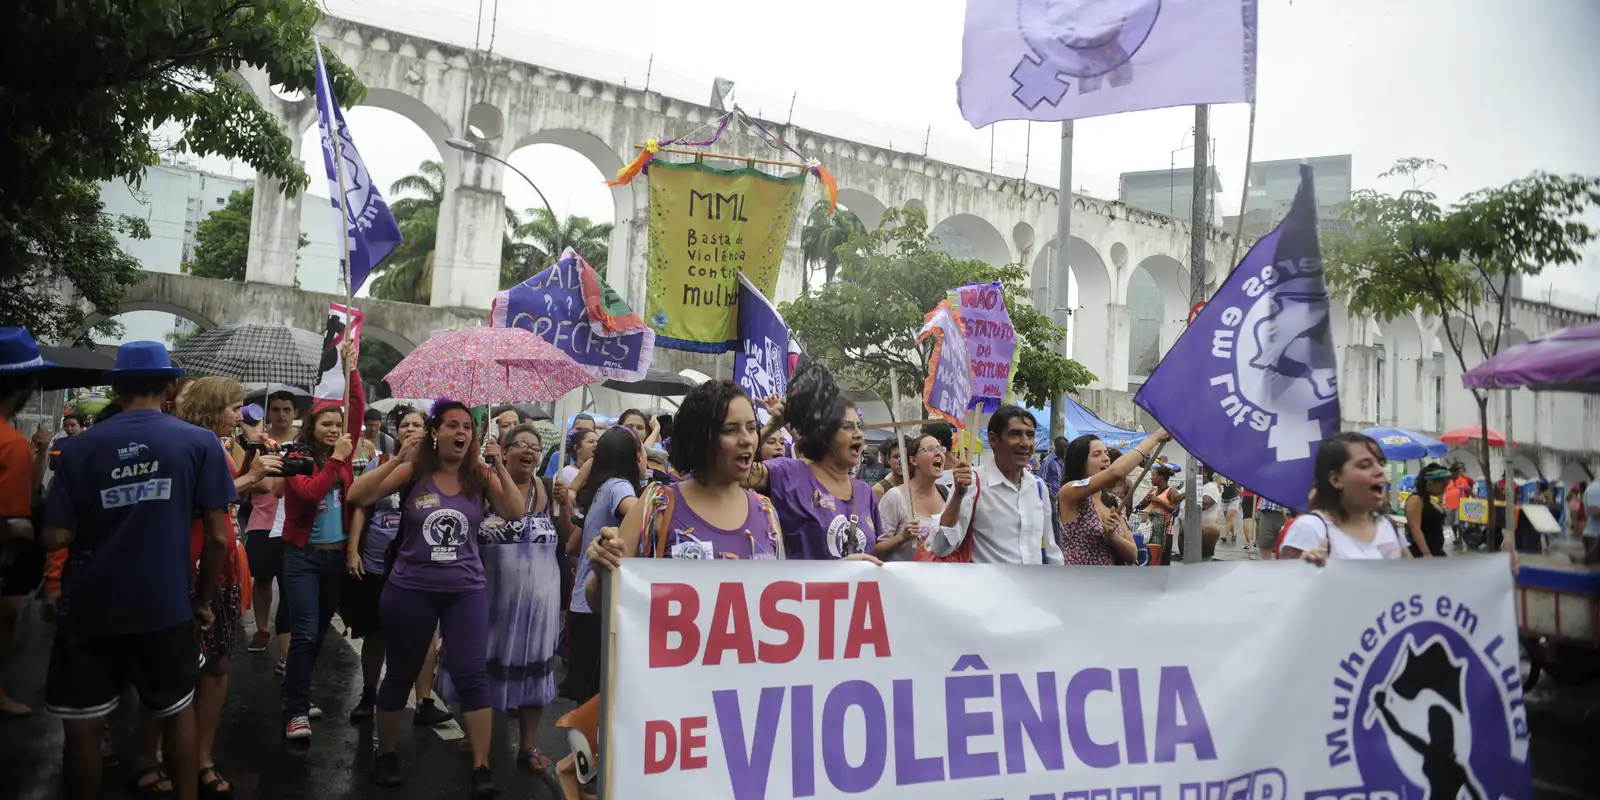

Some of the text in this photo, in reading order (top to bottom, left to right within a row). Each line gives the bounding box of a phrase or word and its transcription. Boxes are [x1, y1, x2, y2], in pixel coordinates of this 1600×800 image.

[689, 189, 748, 222] MML
[687, 229, 743, 247] Basta de
[960, 285, 998, 310] NÃO
[976, 343, 991, 358] DO
[603, 360, 623, 369] MML
[110, 460, 159, 480] CAIXA
[104, 480, 170, 506] STAFF
[647, 580, 892, 669] BASTA
[1325, 593, 1424, 769] Mulheres
[1435, 595, 1479, 636] em
[643, 653, 1218, 800] DE VIOLÊNCIA
